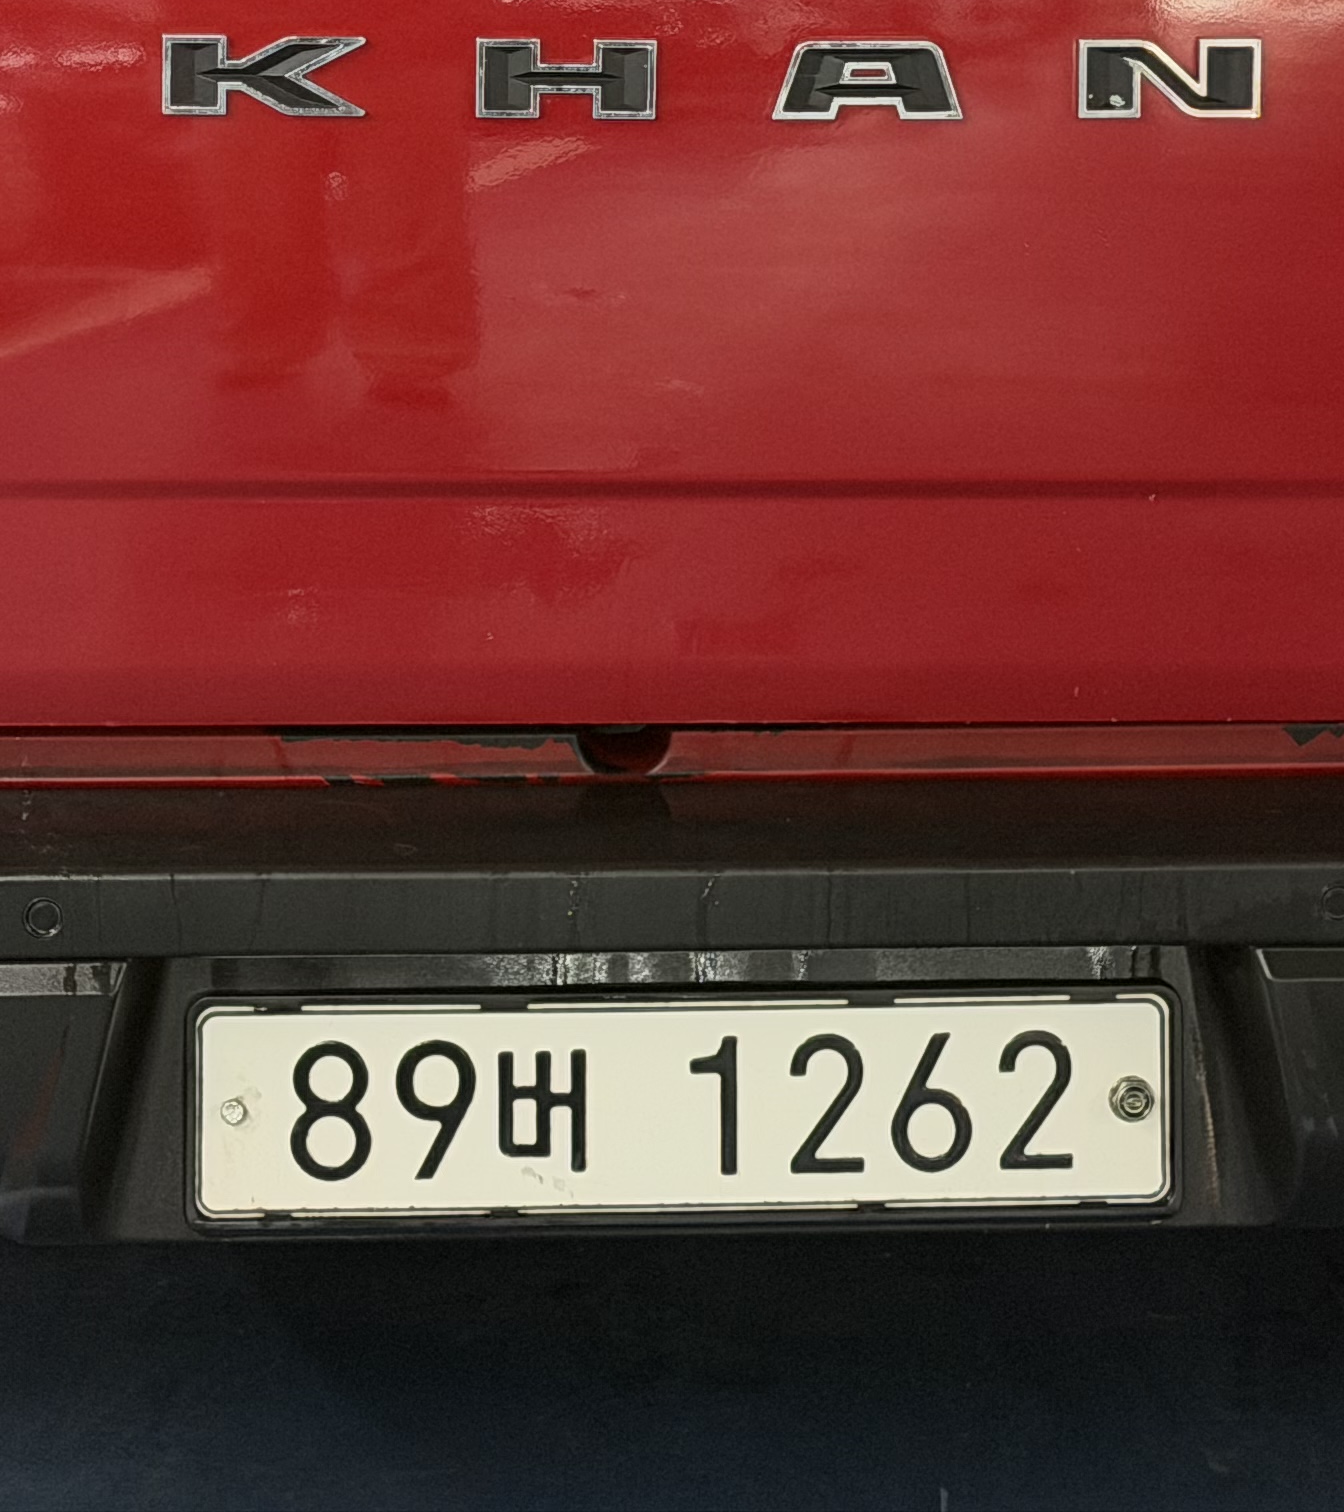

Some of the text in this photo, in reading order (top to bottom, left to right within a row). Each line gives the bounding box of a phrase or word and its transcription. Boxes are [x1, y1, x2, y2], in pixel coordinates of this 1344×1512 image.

[161, 34, 1263, 121] KHAN
[290, 1029, 1073, 1182] 89버 1262
